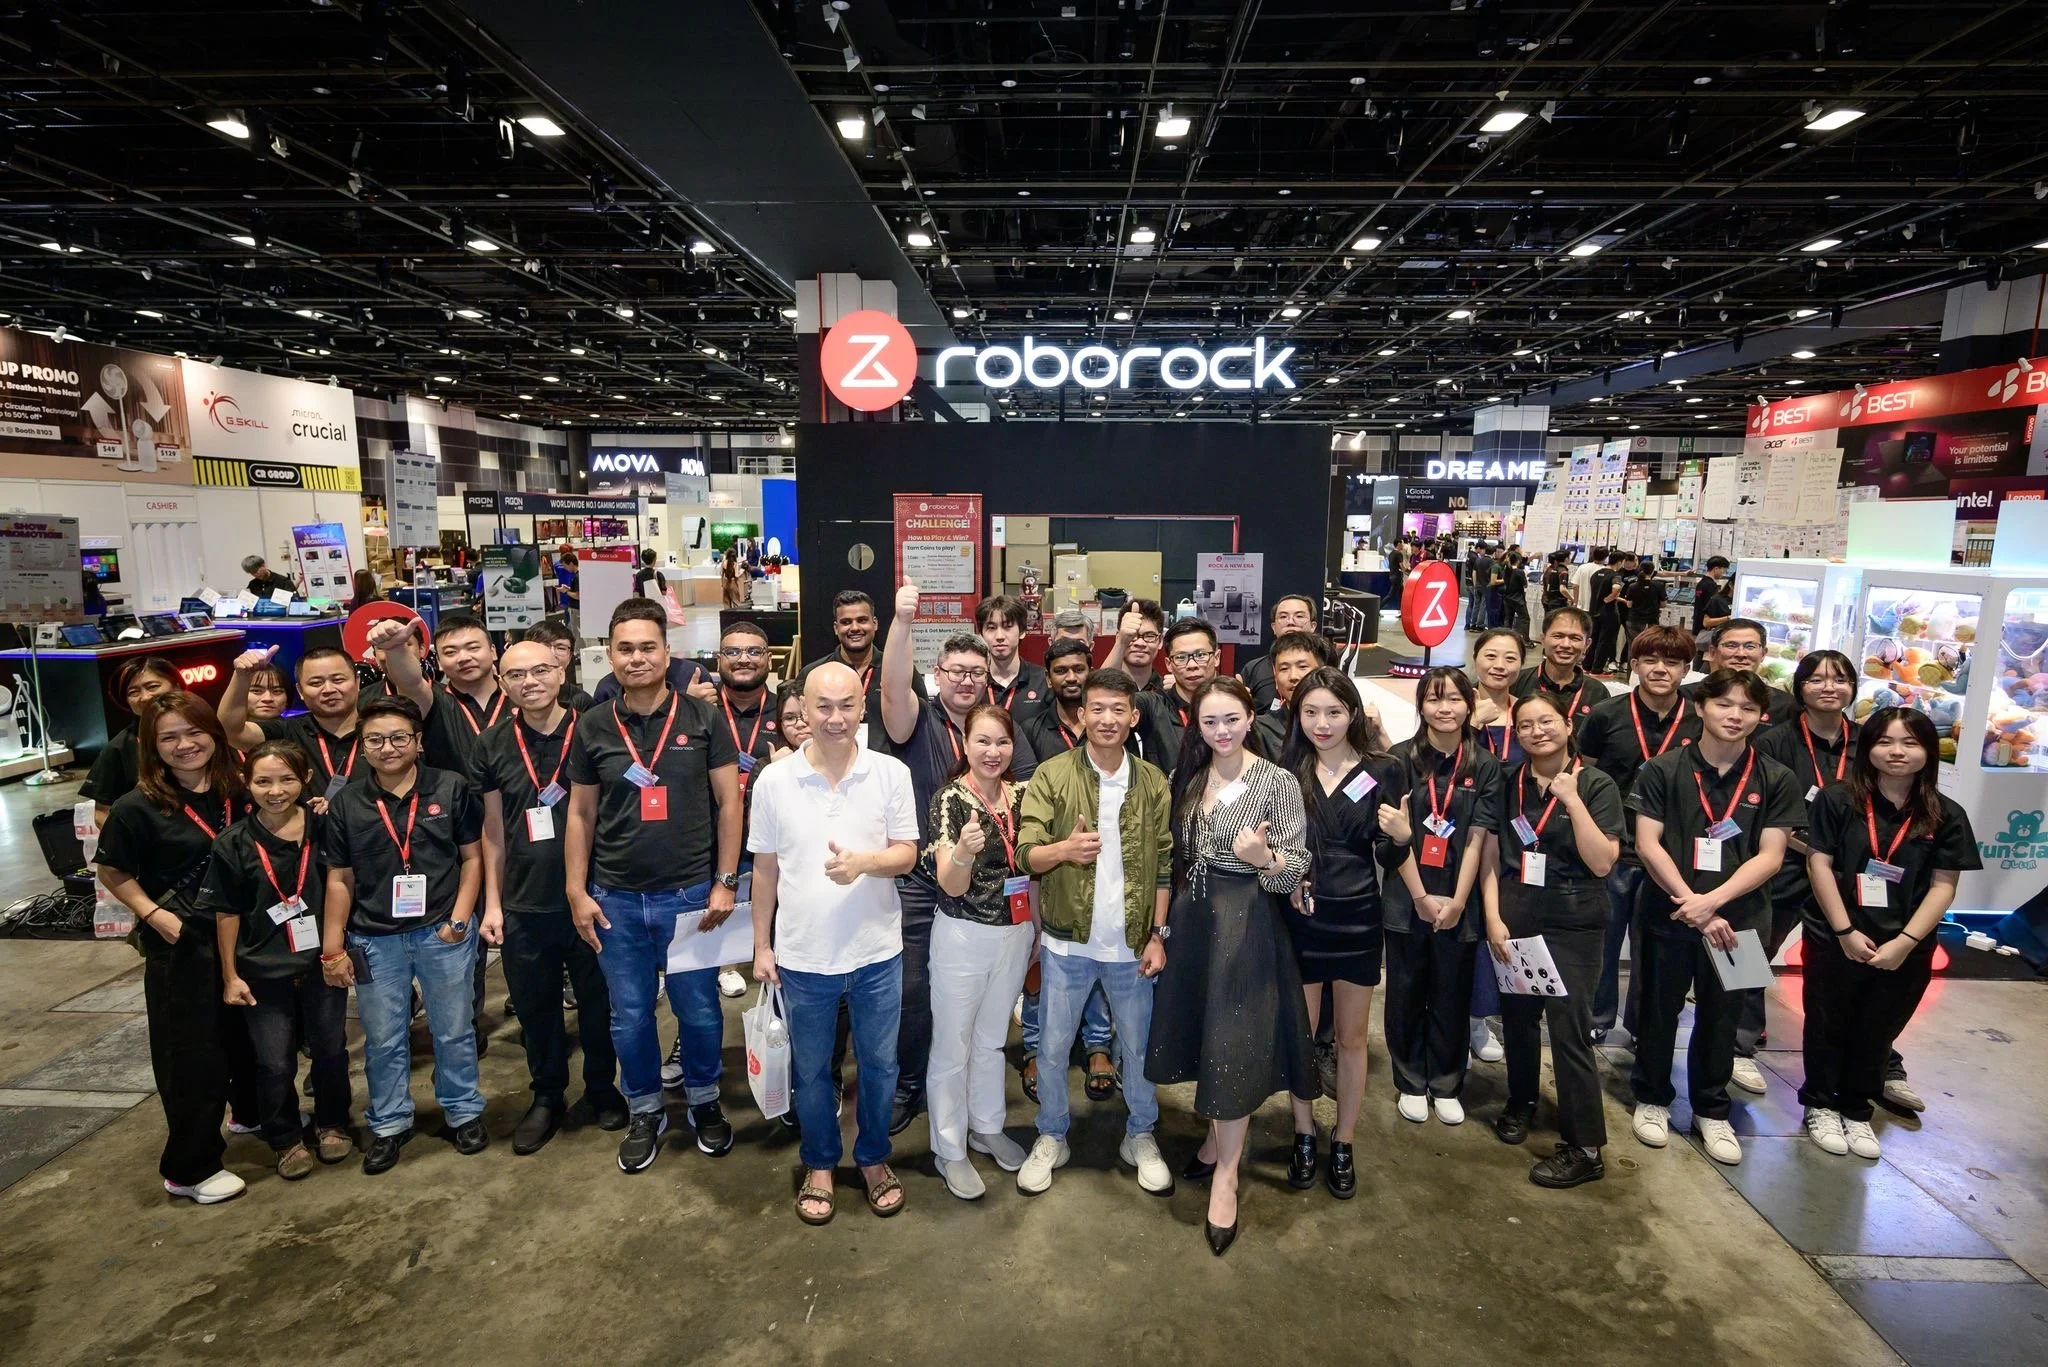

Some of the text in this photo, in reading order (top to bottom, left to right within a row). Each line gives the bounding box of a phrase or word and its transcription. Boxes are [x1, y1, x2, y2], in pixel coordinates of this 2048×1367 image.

[936, 336, 1296, 389] roborock
[21, 364, 79, 385] PROMO
[2026, 371, 2048, 393] B
[6, 381, 37, 392] Breathe
[38, 386, 46, 394] In
[47, 386, 61, 395] The
[62, 389, 81, 398] New!
[1867, 389, 1920, 414] BEST
[4, 402, 41, 412] Circulation
[42, 406, 78, 418] Technology
[12, 411, 29, 419] 50%
[292, 408, 322, 420] micron
[1773, 406, 1813, 426] BEST
[226, 416, 269, 429] G.SKILL
[292, 422, 347, 441] crucial
[2025, 417, 2035, 442] Lenovo
[1764, 439, 1786, 449] acer
[1799, 436, 1814, 444] BEST
[1949, 442, 2008, 455] Your potential
[593, 454, 660, 472] MOVA
[1955, 454, 1998, 465] is limitless
[255, 469, 295, 480] CR GROUP
[1427, 460, 1546, 480] DREAME
[505, 496, 523, 505] AGON
[550, 500, 585, 509] WORLDWIDE
[1448, 496, 1468, 508] NO.
[1956, 490, 1993, 508] intel
[146, 502, 178, 510] CASHIER
[13, 523, 47, 531] SHOW
[905, 518, 970, 528] CHALLENGE!
[931, 534, 946, 542] Play
